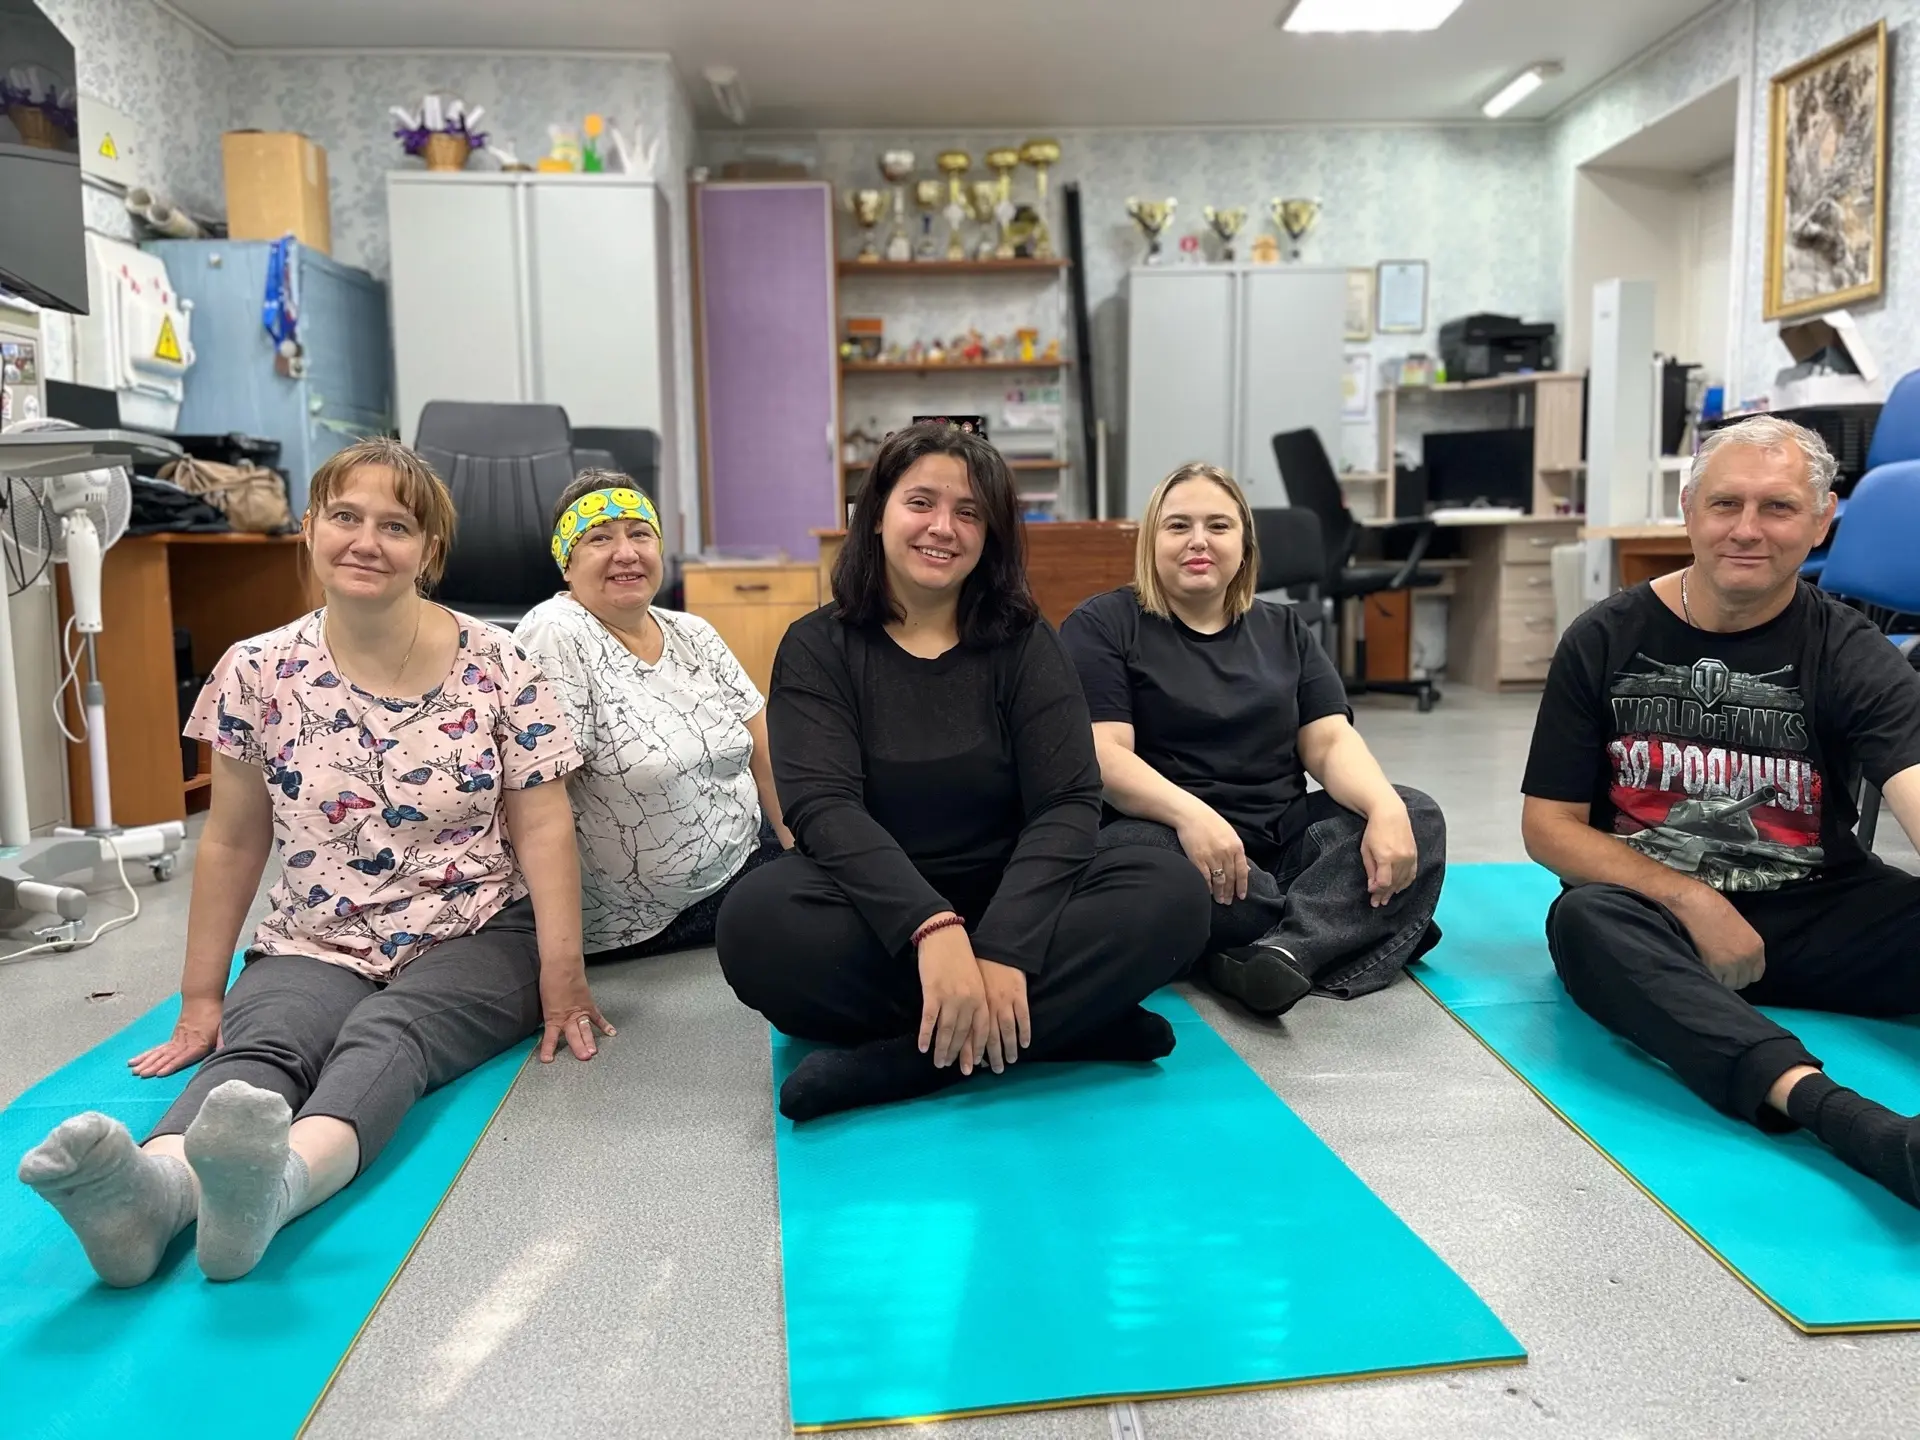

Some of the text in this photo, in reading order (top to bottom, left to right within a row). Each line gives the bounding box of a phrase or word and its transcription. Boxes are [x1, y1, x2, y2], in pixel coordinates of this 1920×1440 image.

[1611, 696, 1809, 751] WORLD OF TANKS
[1610, 740, 1813, 815] ЗА РОДИНУ!
